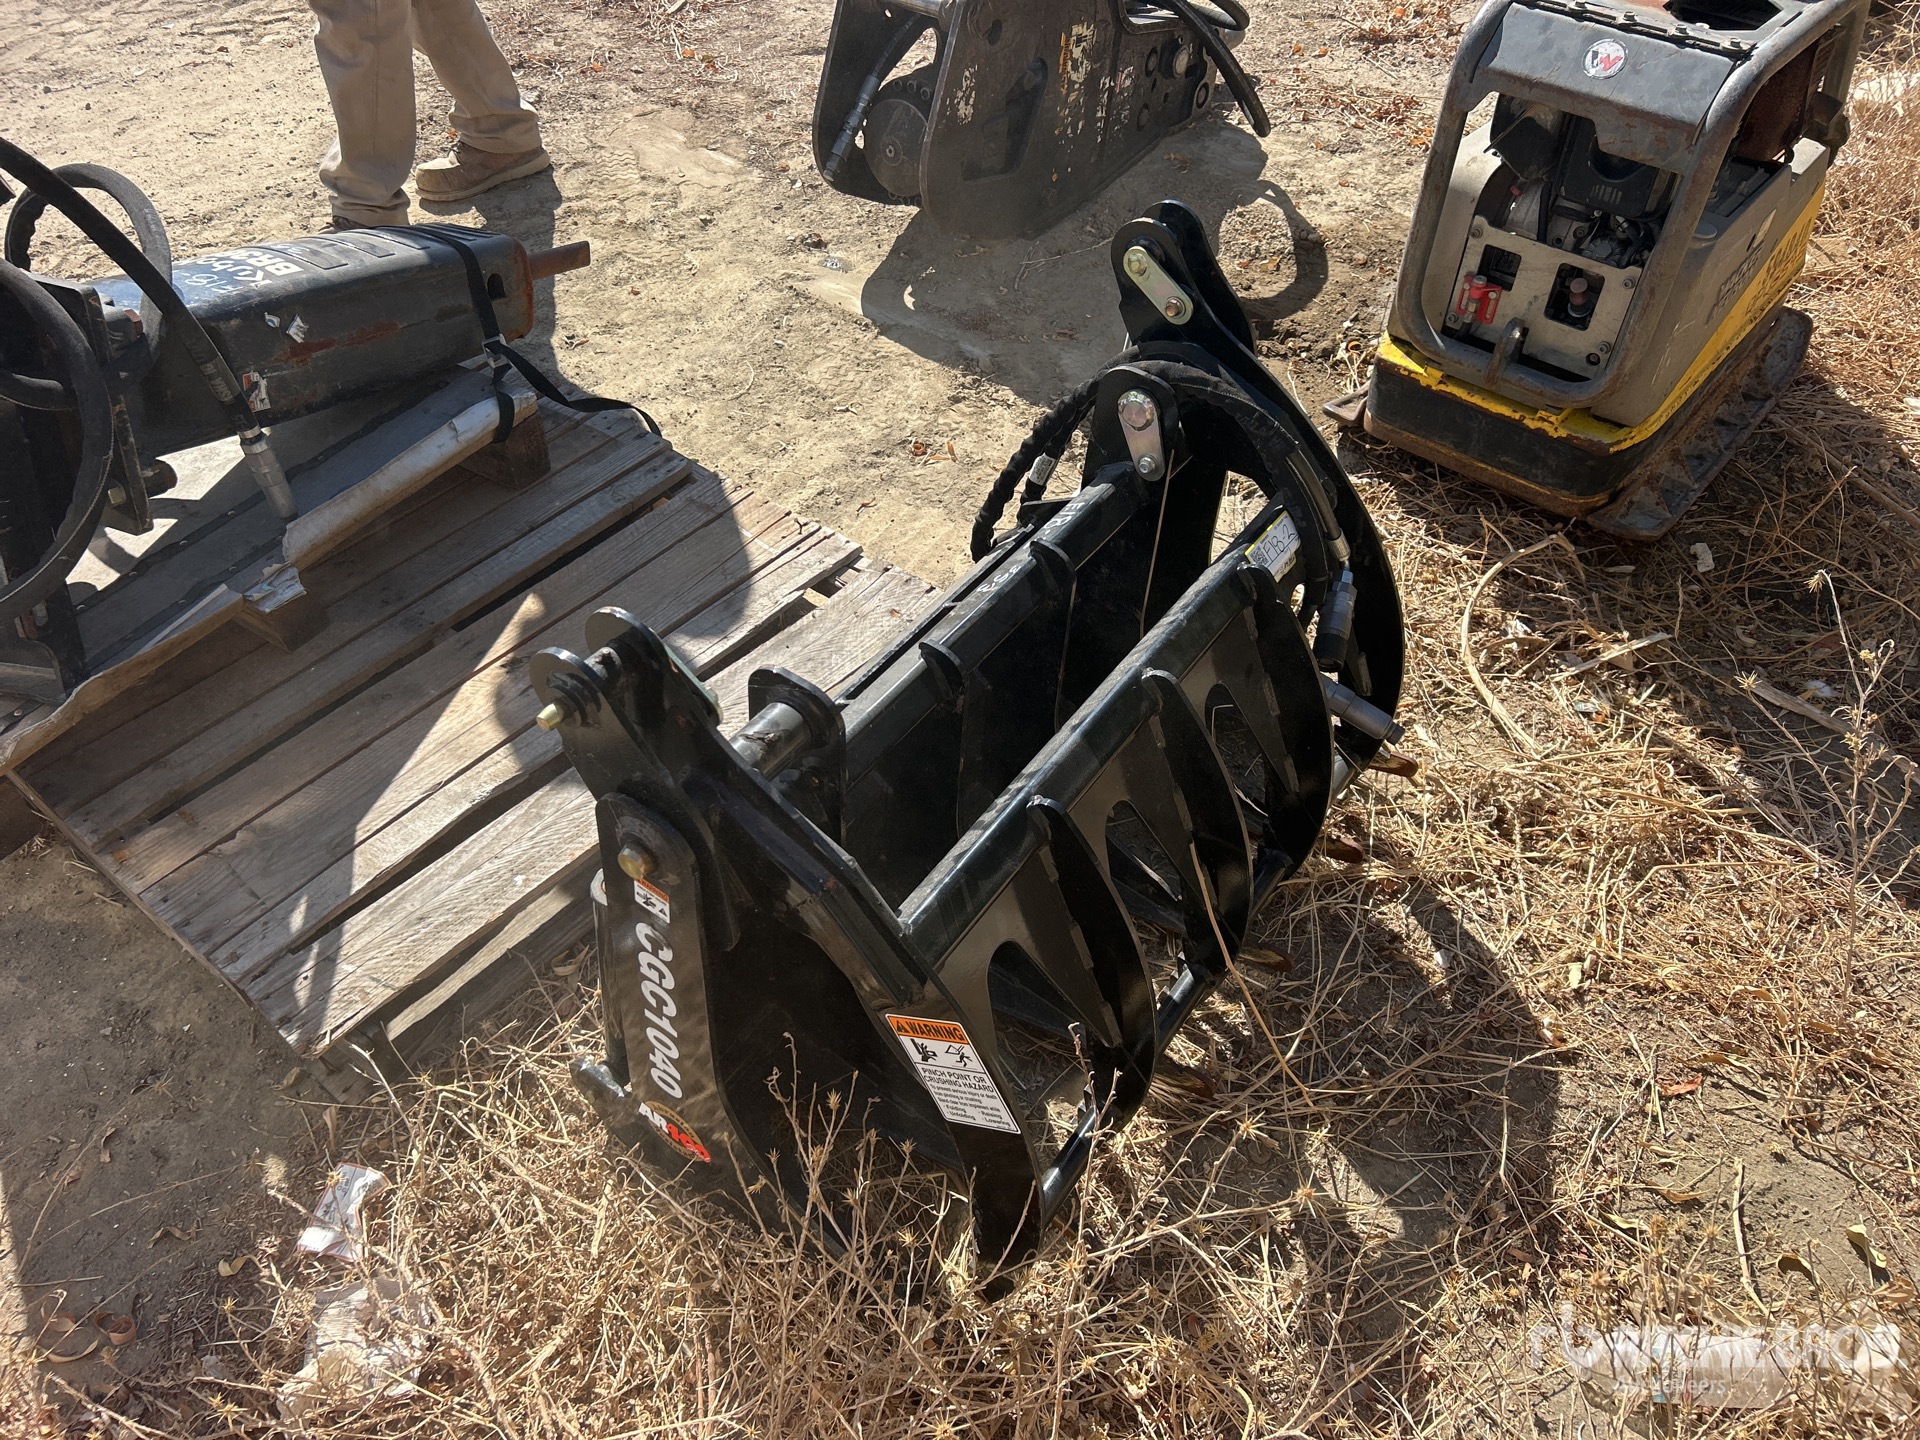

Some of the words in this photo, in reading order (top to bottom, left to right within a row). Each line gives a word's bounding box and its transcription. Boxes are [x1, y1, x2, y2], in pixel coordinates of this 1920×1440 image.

[635, 922, 684, 1099] CGC1040
[904, 1021, 965, 1041] WARNING
[921, 1067, 947, 1078] PINCH
[947, 1071, 972, 1081] POINT
[972, 1075, 987, 1084] OR
[923, 1075, 962, 1087] CRUSHING
[961, 1081, 994, 1093] HAZARD
